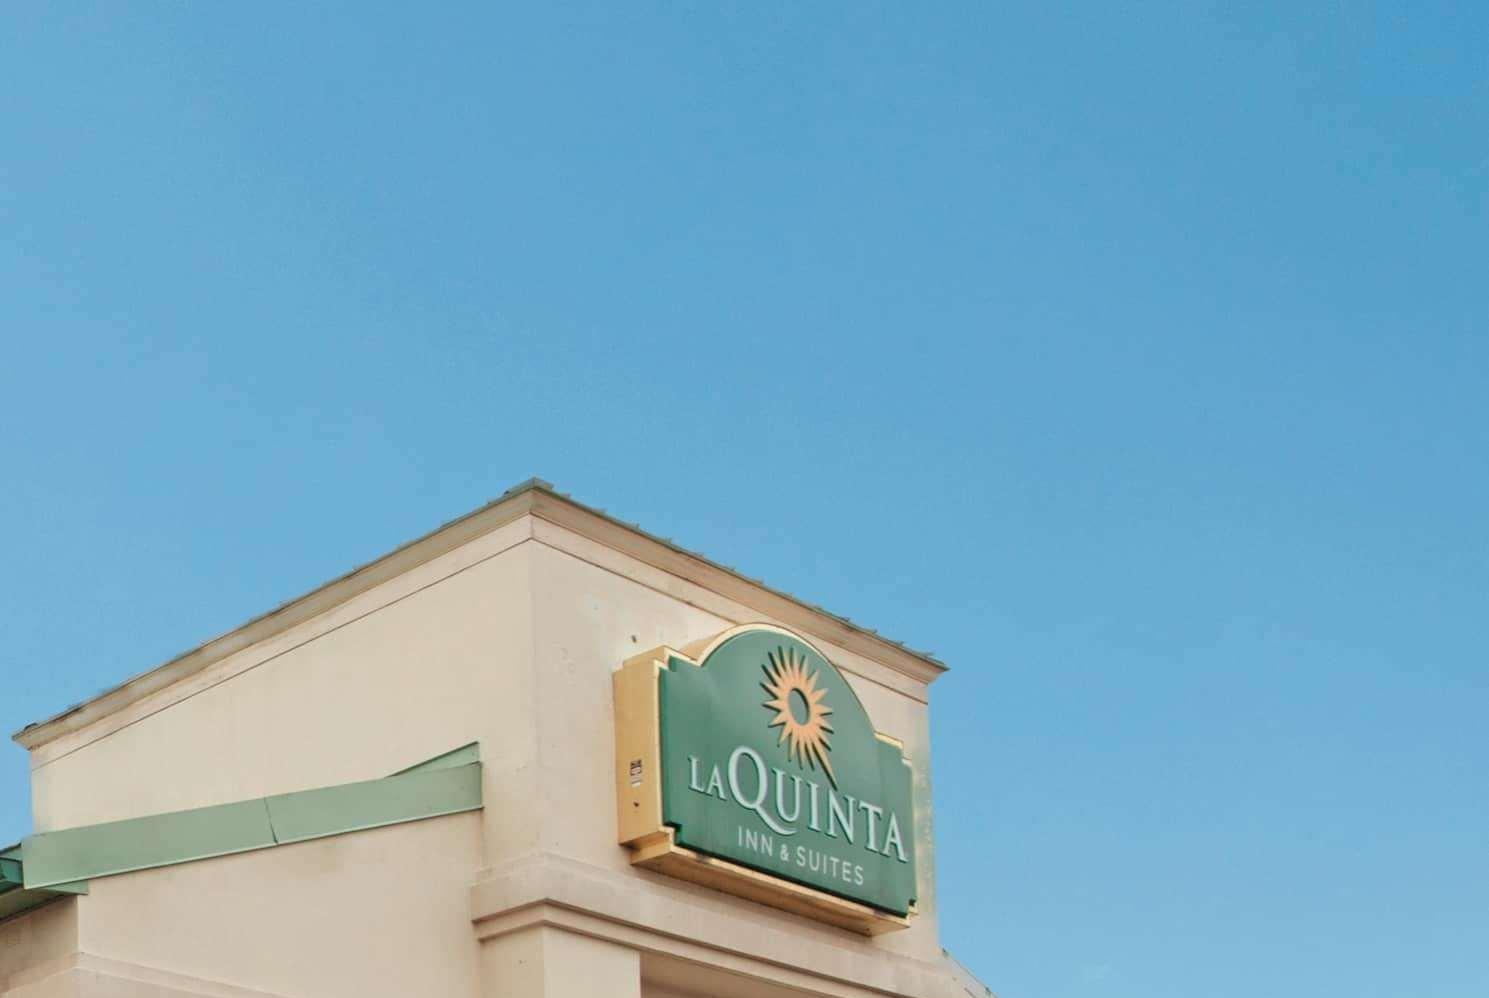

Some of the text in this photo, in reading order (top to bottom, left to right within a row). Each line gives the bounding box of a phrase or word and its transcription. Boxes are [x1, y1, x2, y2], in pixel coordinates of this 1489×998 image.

[738, 826, 865, 886] INN & SUITES
